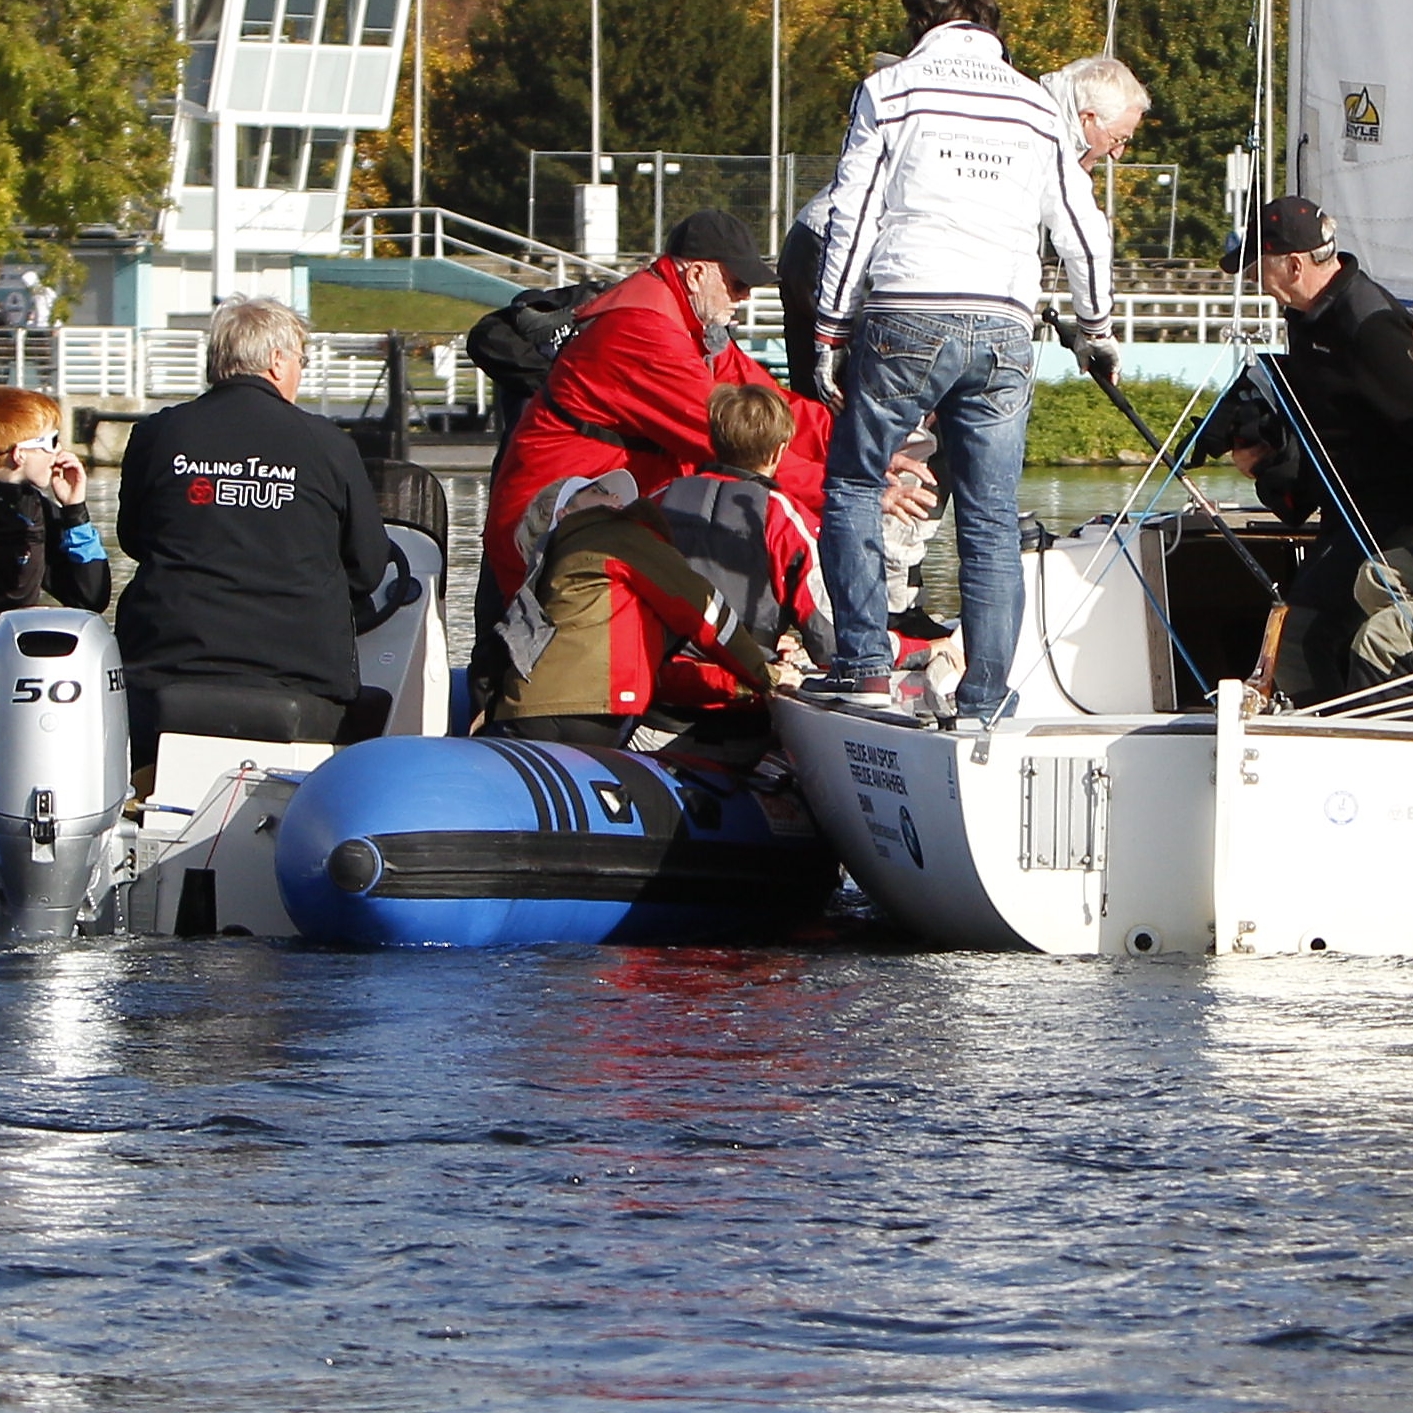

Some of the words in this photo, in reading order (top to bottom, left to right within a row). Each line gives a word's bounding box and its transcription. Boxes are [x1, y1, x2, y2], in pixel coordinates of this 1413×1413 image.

[922, 64, 1021, 87] SEASHORE
[921, 131, 1029, 149] PORSCHE
[939, 149, 1014, 165] H-BOOT
[956, 167, 1000, 181] 1306
[215, 478, 295, 509] ETUF
[12, 678, 82, 704] 50
